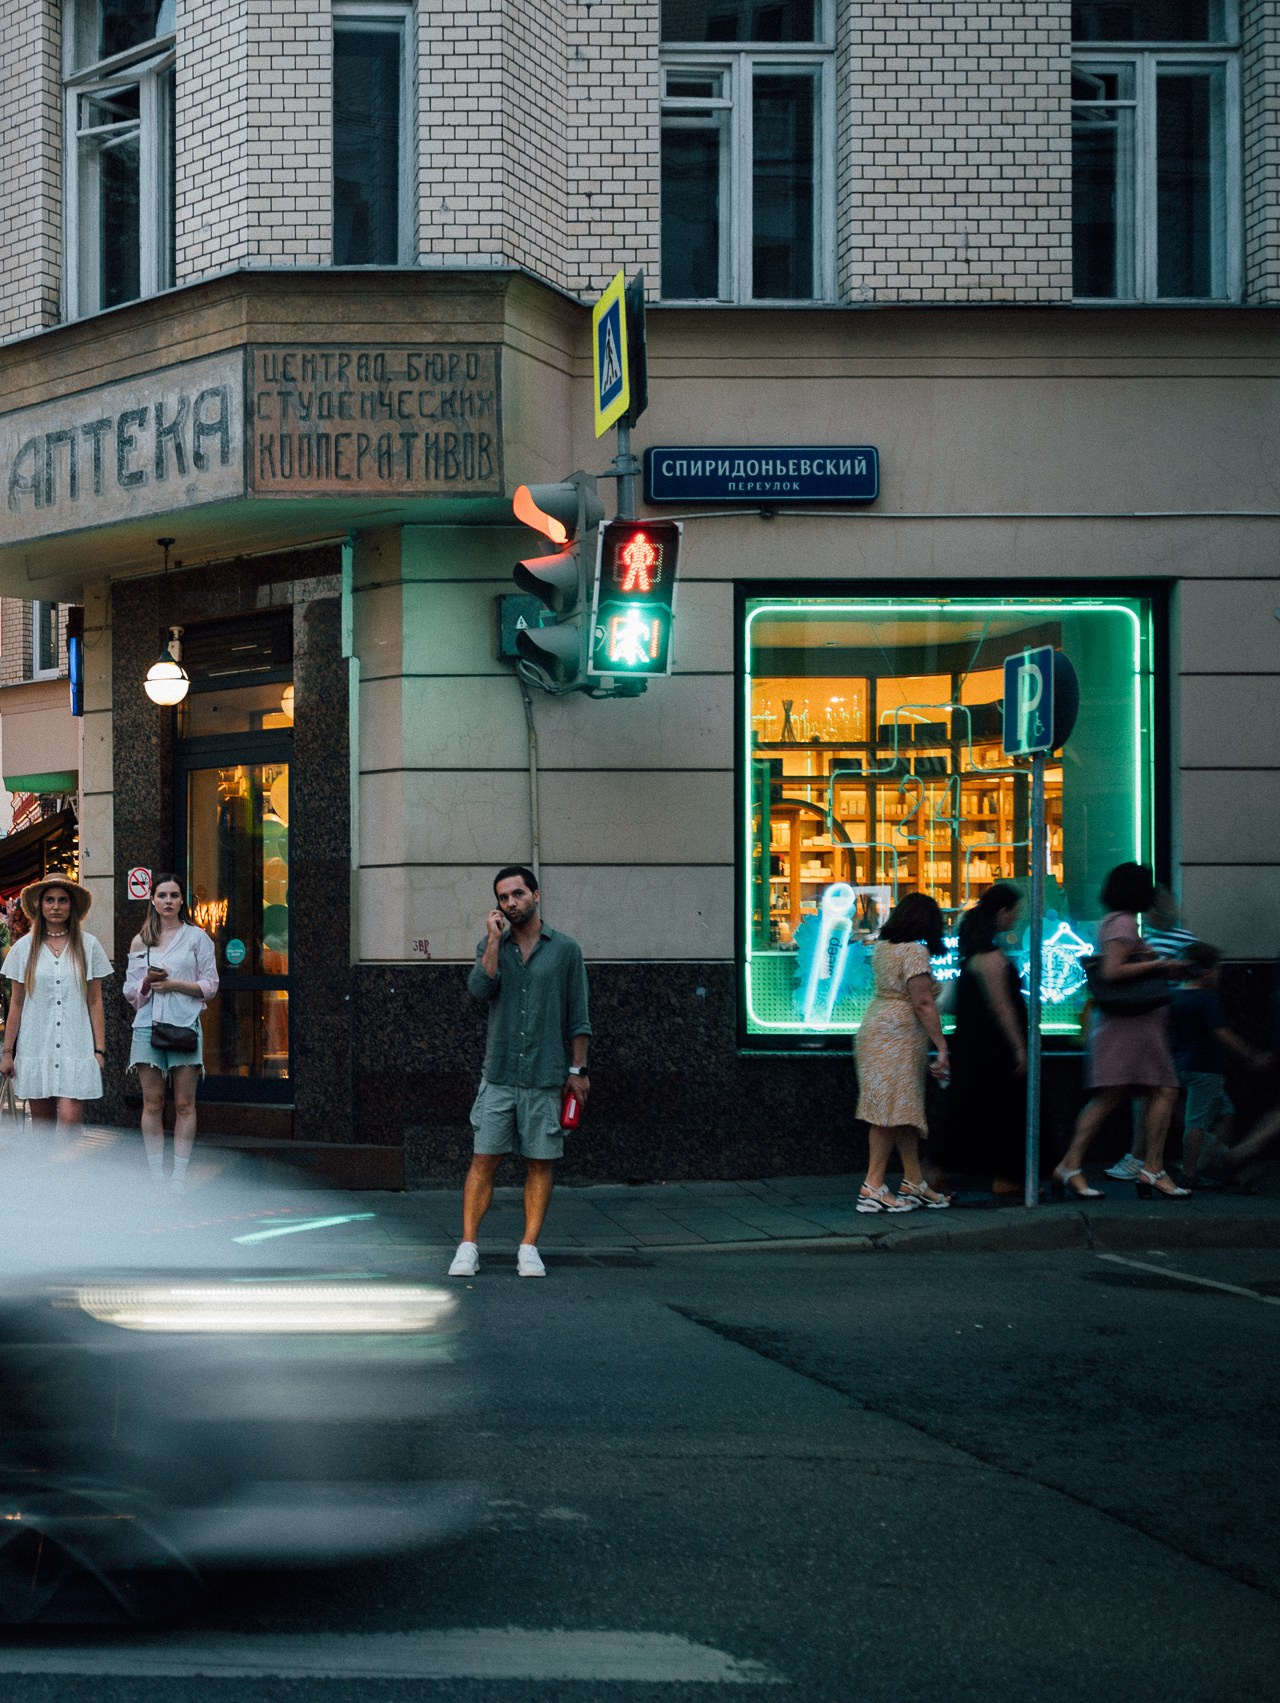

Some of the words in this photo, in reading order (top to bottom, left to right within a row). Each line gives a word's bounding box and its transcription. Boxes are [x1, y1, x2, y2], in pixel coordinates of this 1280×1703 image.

[406, 352, 481, 382] БЮРО
[256, 390, 495, 421] СТУДЕНЧЕСКИХ
[7, 384, 232, 513] АПТЕКА
[259, 431, 495, 482] КООПЕРАТИВОВ
[661, 456, 868, 478] СПИРИДОНЬЕВСКИЙ
[727, 481, 801, 491] ПЕРЕУЛОК
[1017, 664, 1043, 740] P
[897, 774, 968, 838] 24
